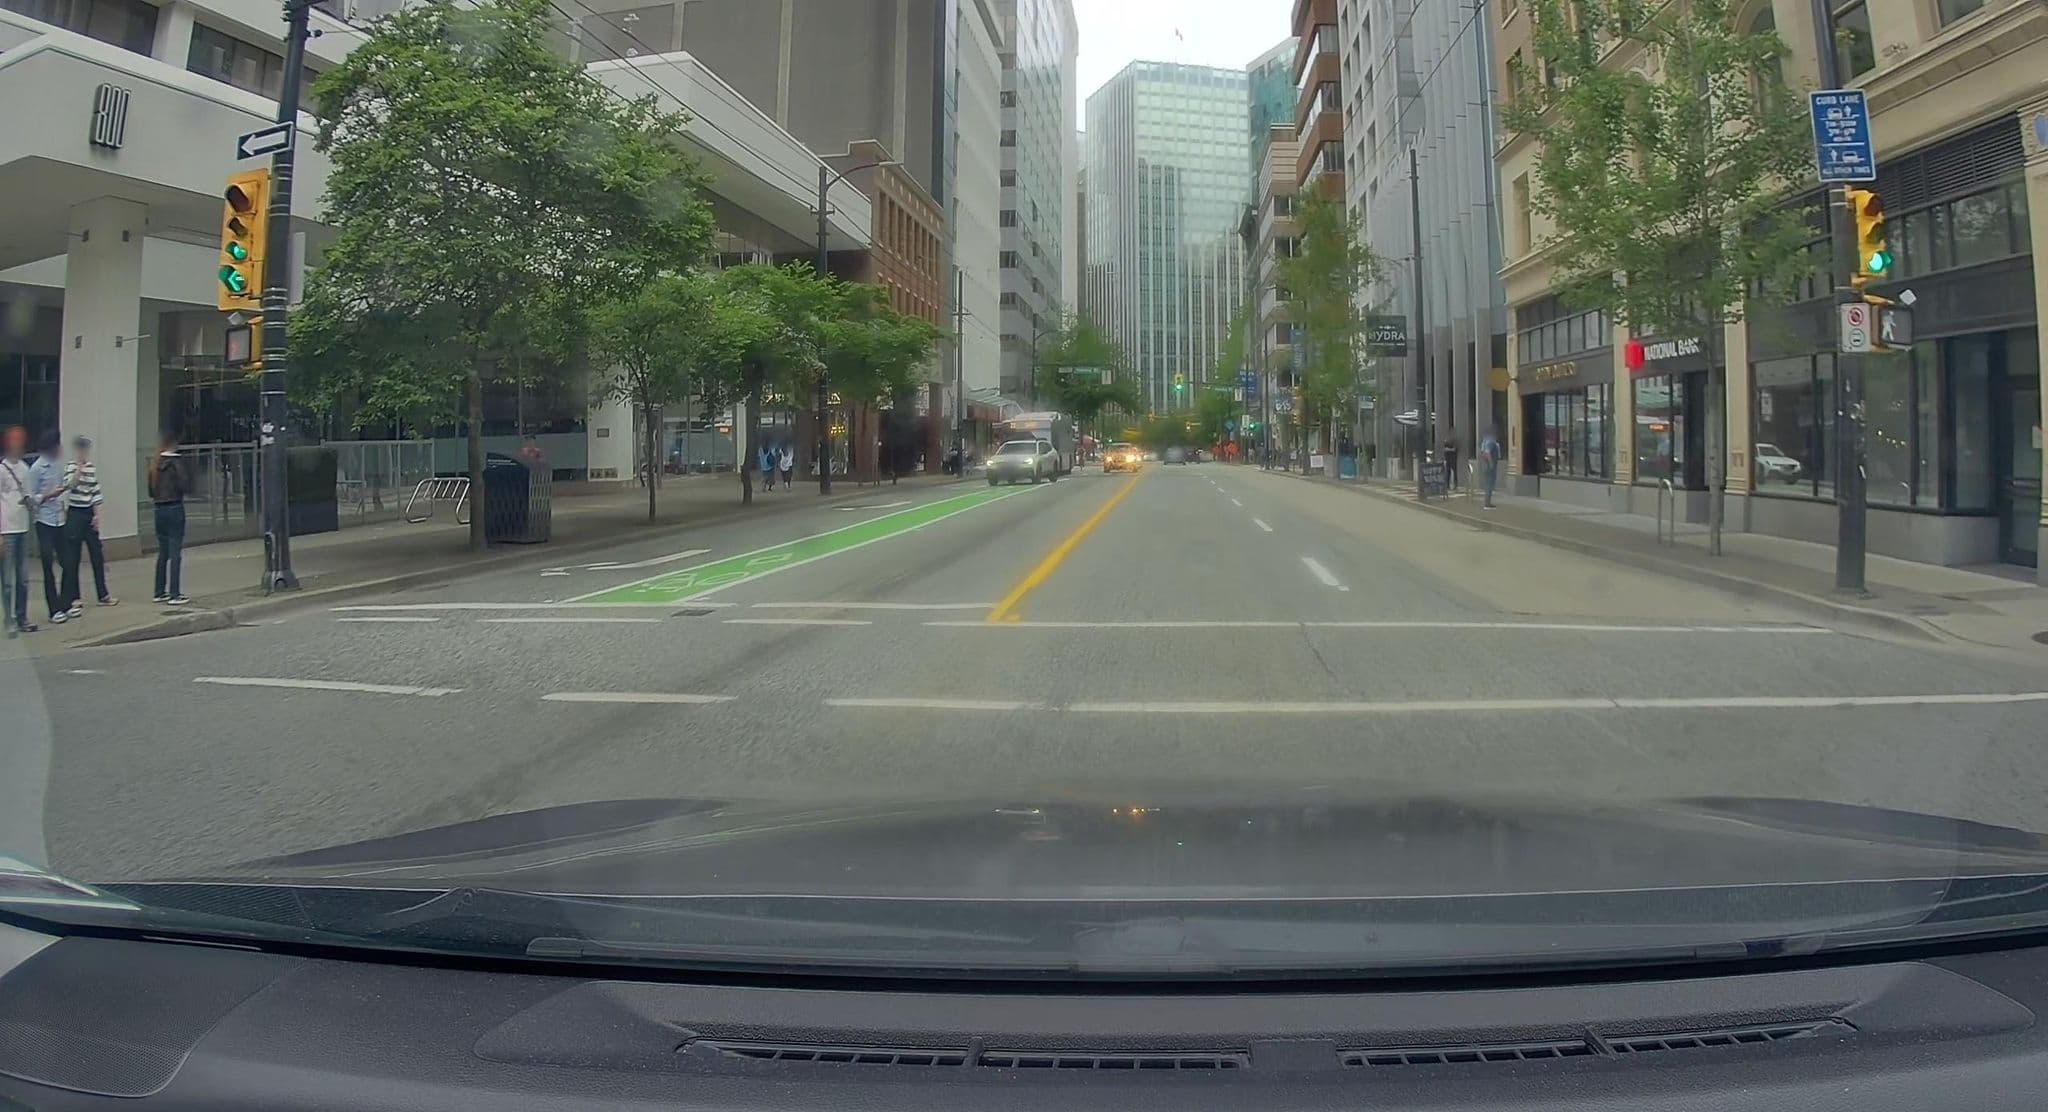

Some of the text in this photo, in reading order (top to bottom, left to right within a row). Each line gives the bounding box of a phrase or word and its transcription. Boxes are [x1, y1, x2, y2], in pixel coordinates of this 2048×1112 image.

[1816, 95, 1860, 105] CURB LANE
[1368, 331, 1405, 342] HYDRA
[1644, 337, 1700, 361] NATIONAL BANK
